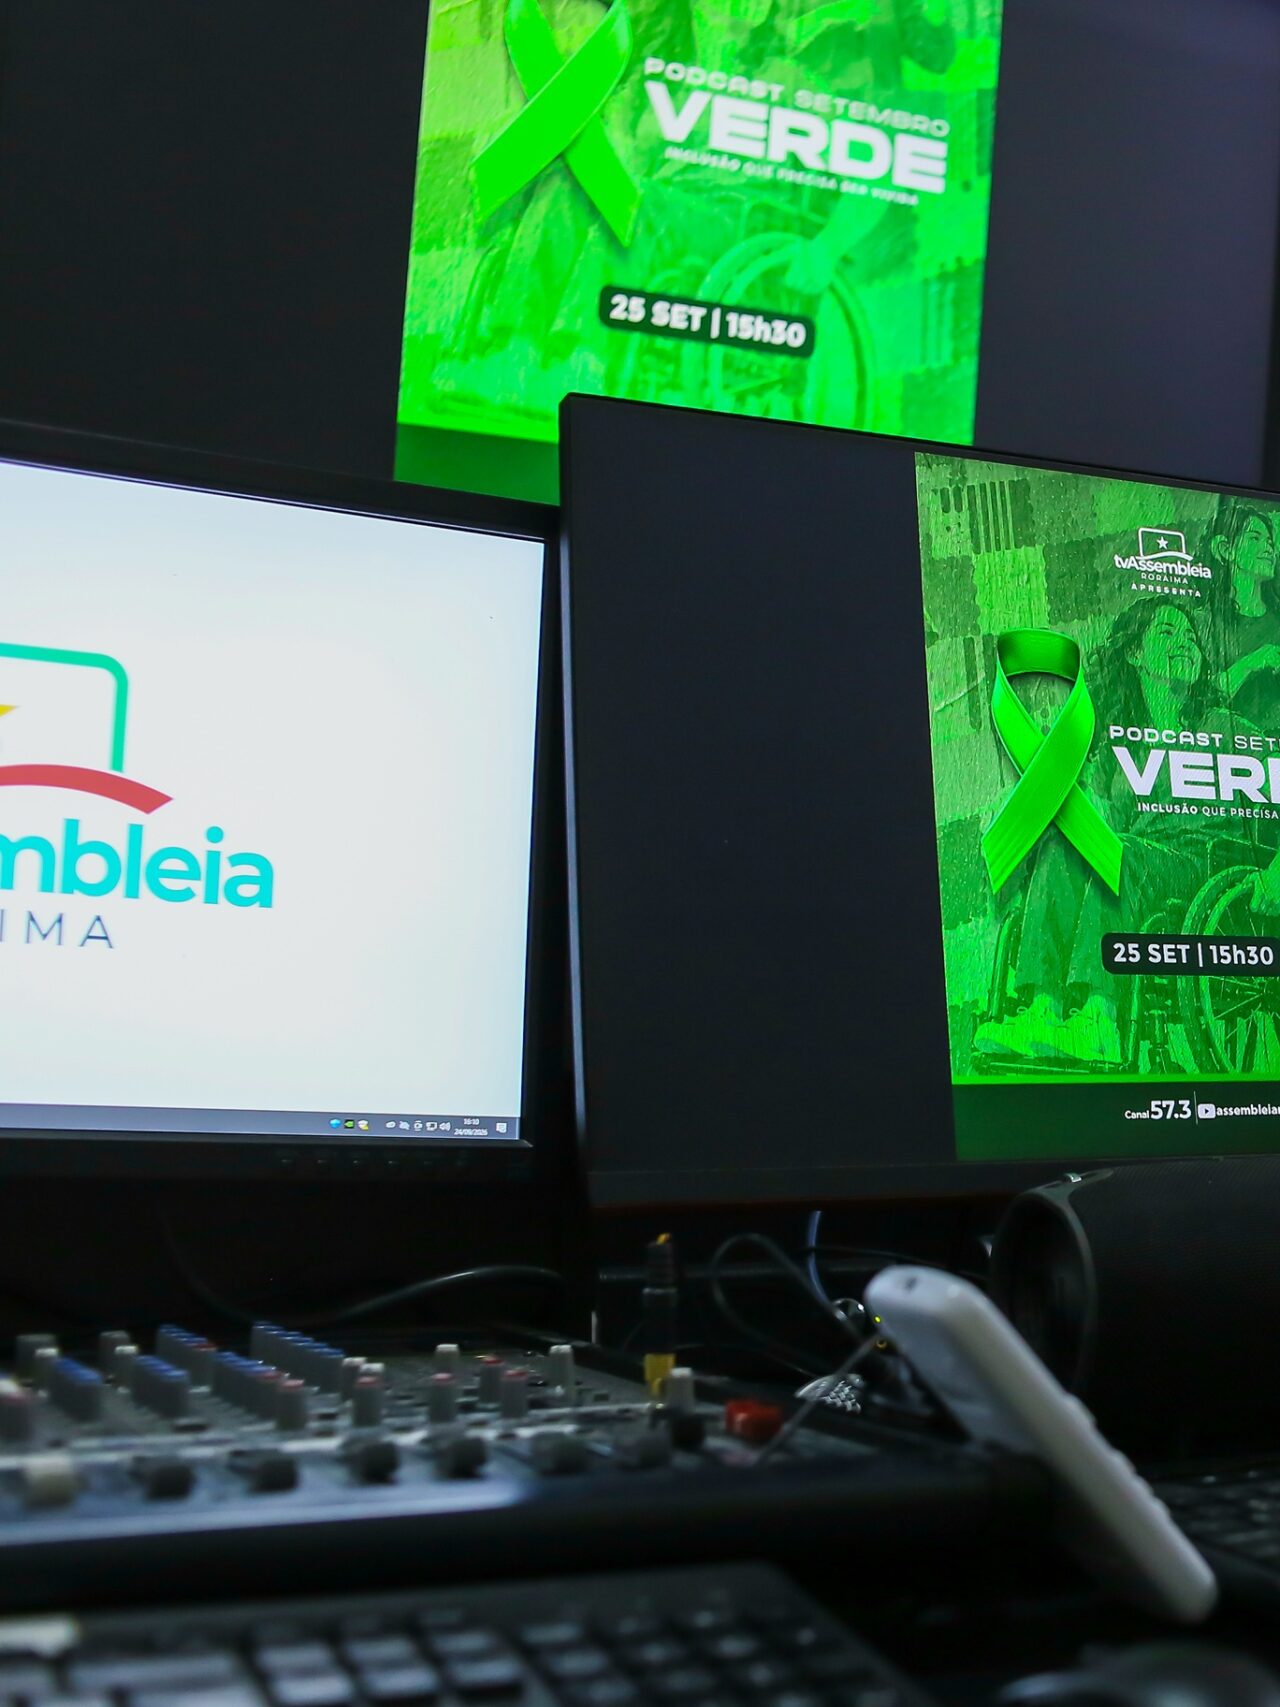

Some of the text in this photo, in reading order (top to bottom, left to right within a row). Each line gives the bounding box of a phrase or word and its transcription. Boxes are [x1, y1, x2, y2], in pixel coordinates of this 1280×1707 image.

[644, 57, 950, 138] PODCAST SETEMBRO
[645, 80, 947, 194] VERDE
[609, 294, 646, 323] 25
[651, 300, 707, 332] SET
[726, 312, 806, 348] 15h30
[1141, 572, 1188, 584] RORAIMA
[1131, 582, 1201, 598] APRESENTA
[1110, 725, 1222, 747] PODCAST
[1137, 802, 1198, 815] INCLUSÃO
[1202, 806, 1226, 818] QUE
[1113, 943, 1140, 963] 25
[1148, 943, 1190, 964] SET
[1209, 944, 1274, 965] 15h30
[1124, 1100, 1192, 1119] Canal 57.3
